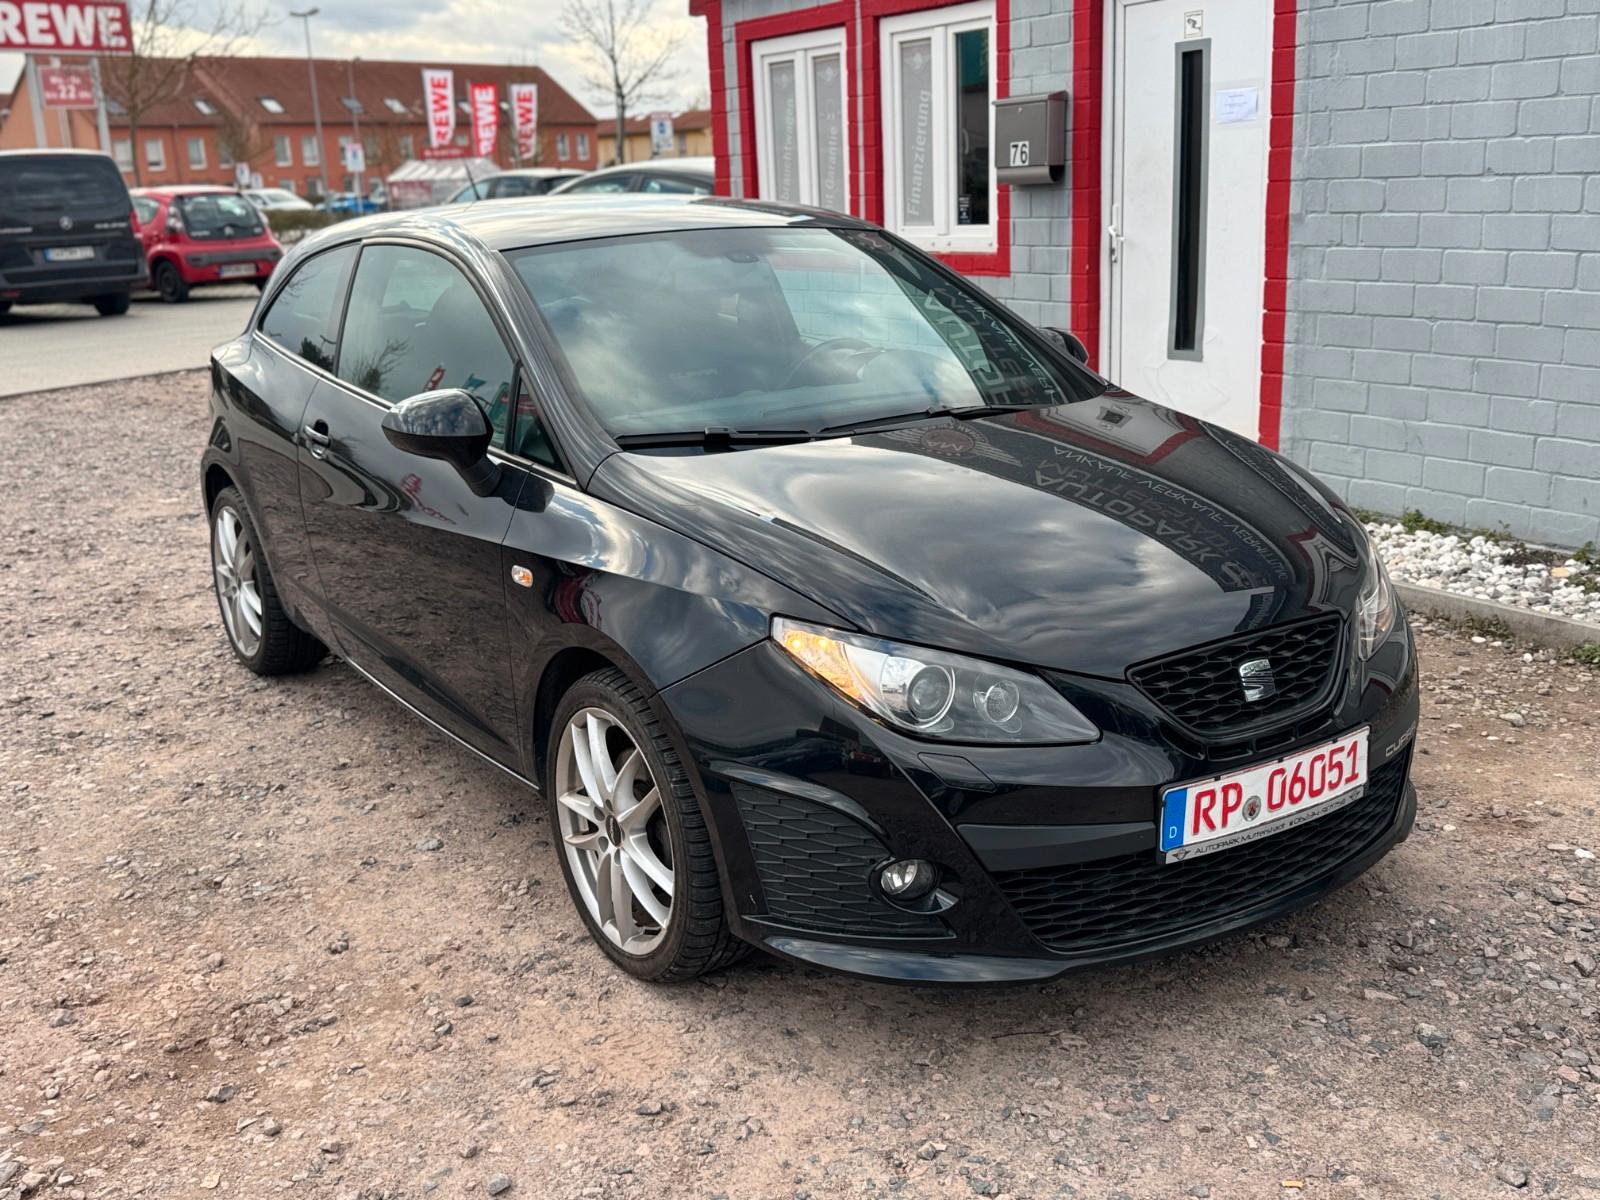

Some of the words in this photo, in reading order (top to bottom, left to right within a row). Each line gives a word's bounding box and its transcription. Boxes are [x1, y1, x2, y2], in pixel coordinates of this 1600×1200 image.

[0, 2, 127, 47] REWE
[430, 76, 449, 142] REWE
[475, 86, 497, 155] REWE
[516, 91, 533, 155] REWE
[781, 97, 795, 200] brauchtwagen
[906, 89, 932, 217] Finanzierung
[1011, 144, 1028, 164] 76
[1192, 782, 1243, 836] RP
[1267, 740, 1359, 812] 06051
[1169, 826, 1178, 839] D
[1194, 838, 1239, 855] AUTOPARK
